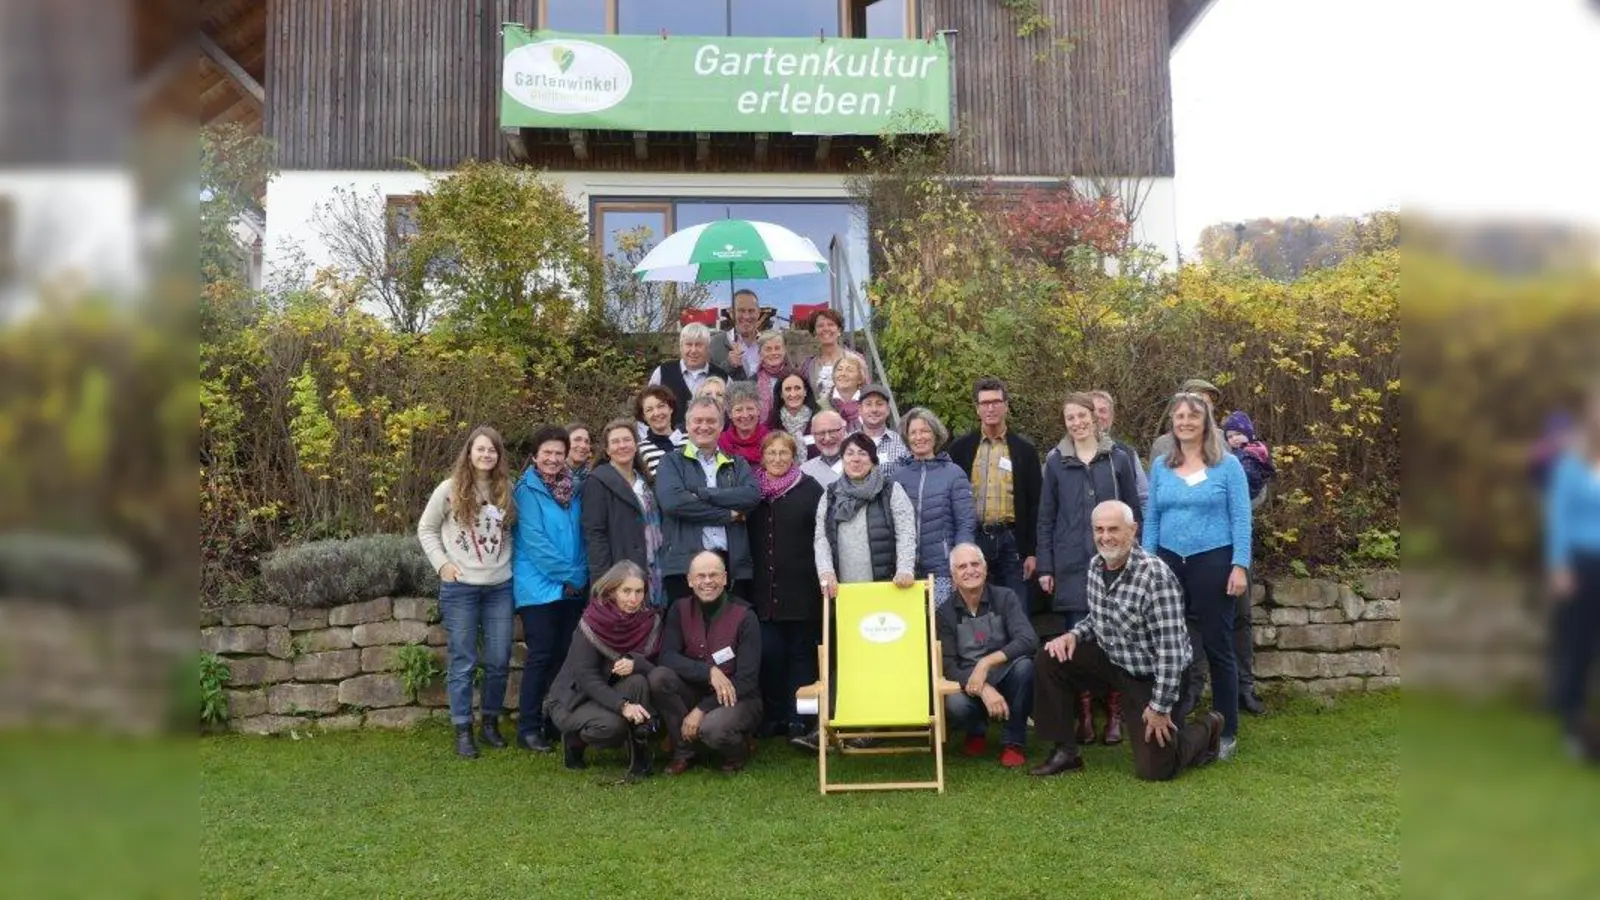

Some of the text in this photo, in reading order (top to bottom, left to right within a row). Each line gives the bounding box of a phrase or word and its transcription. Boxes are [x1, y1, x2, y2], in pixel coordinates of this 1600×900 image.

[694, 44, 937, 79] Gartenkultur
[514, 71, 618, 92] Gartenwinkel
[737, 83, 897, 115] erleben!
